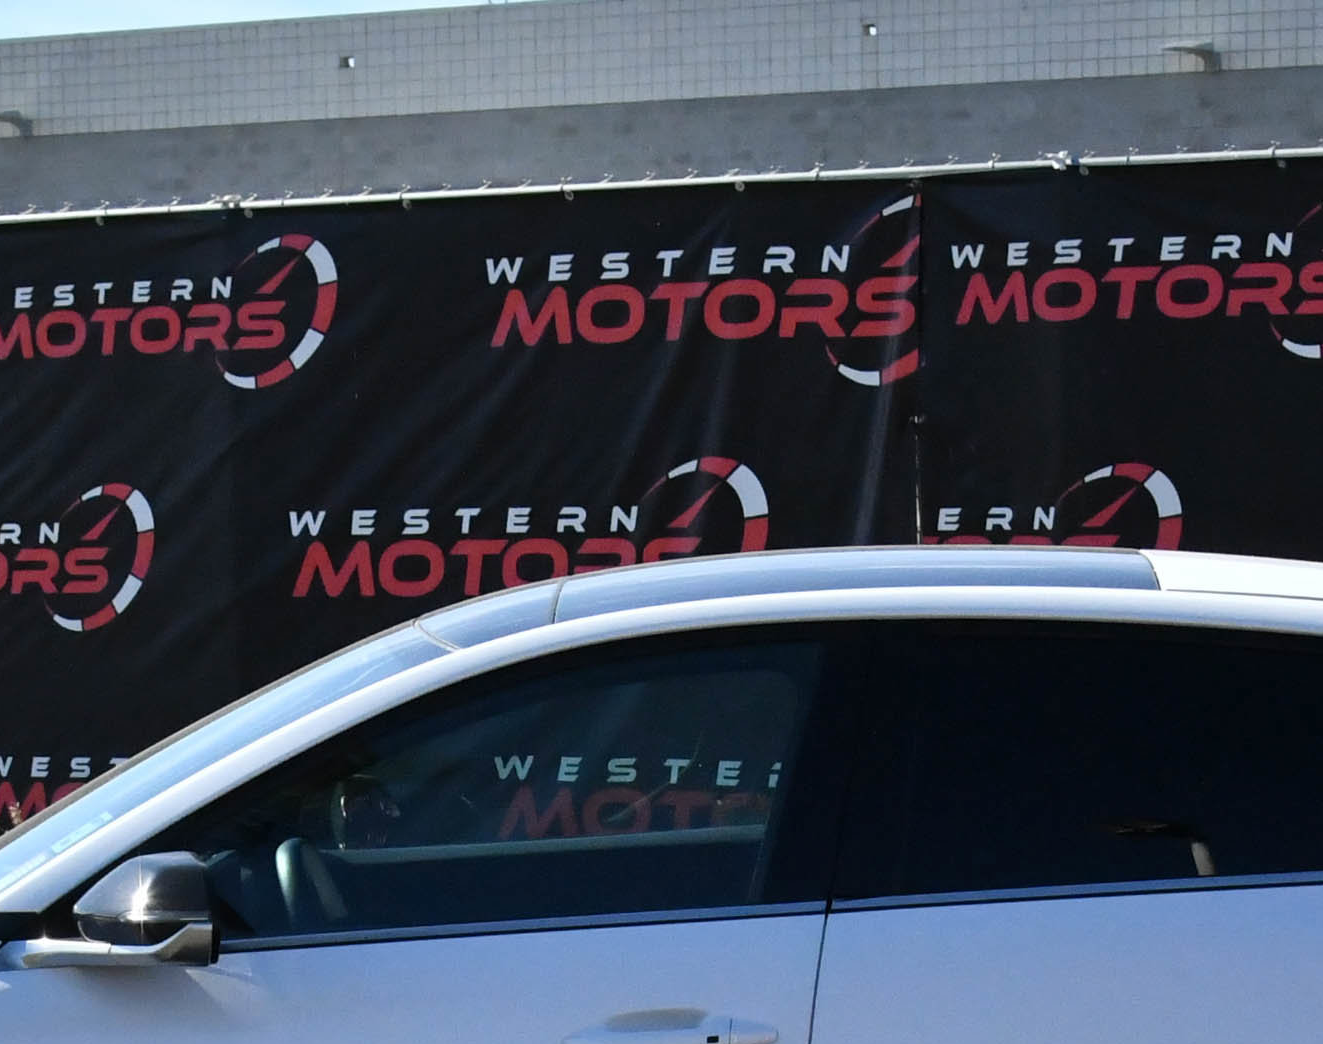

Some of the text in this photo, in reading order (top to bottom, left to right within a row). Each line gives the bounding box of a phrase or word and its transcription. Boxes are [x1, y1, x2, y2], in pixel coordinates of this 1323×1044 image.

[485, 244, 850, 285] WESTERN
[951, 232, 1293, 269] WESTERN
[491, 275, 917, 347] MOTORS
[289, 505, 638, 537] WESTERN
